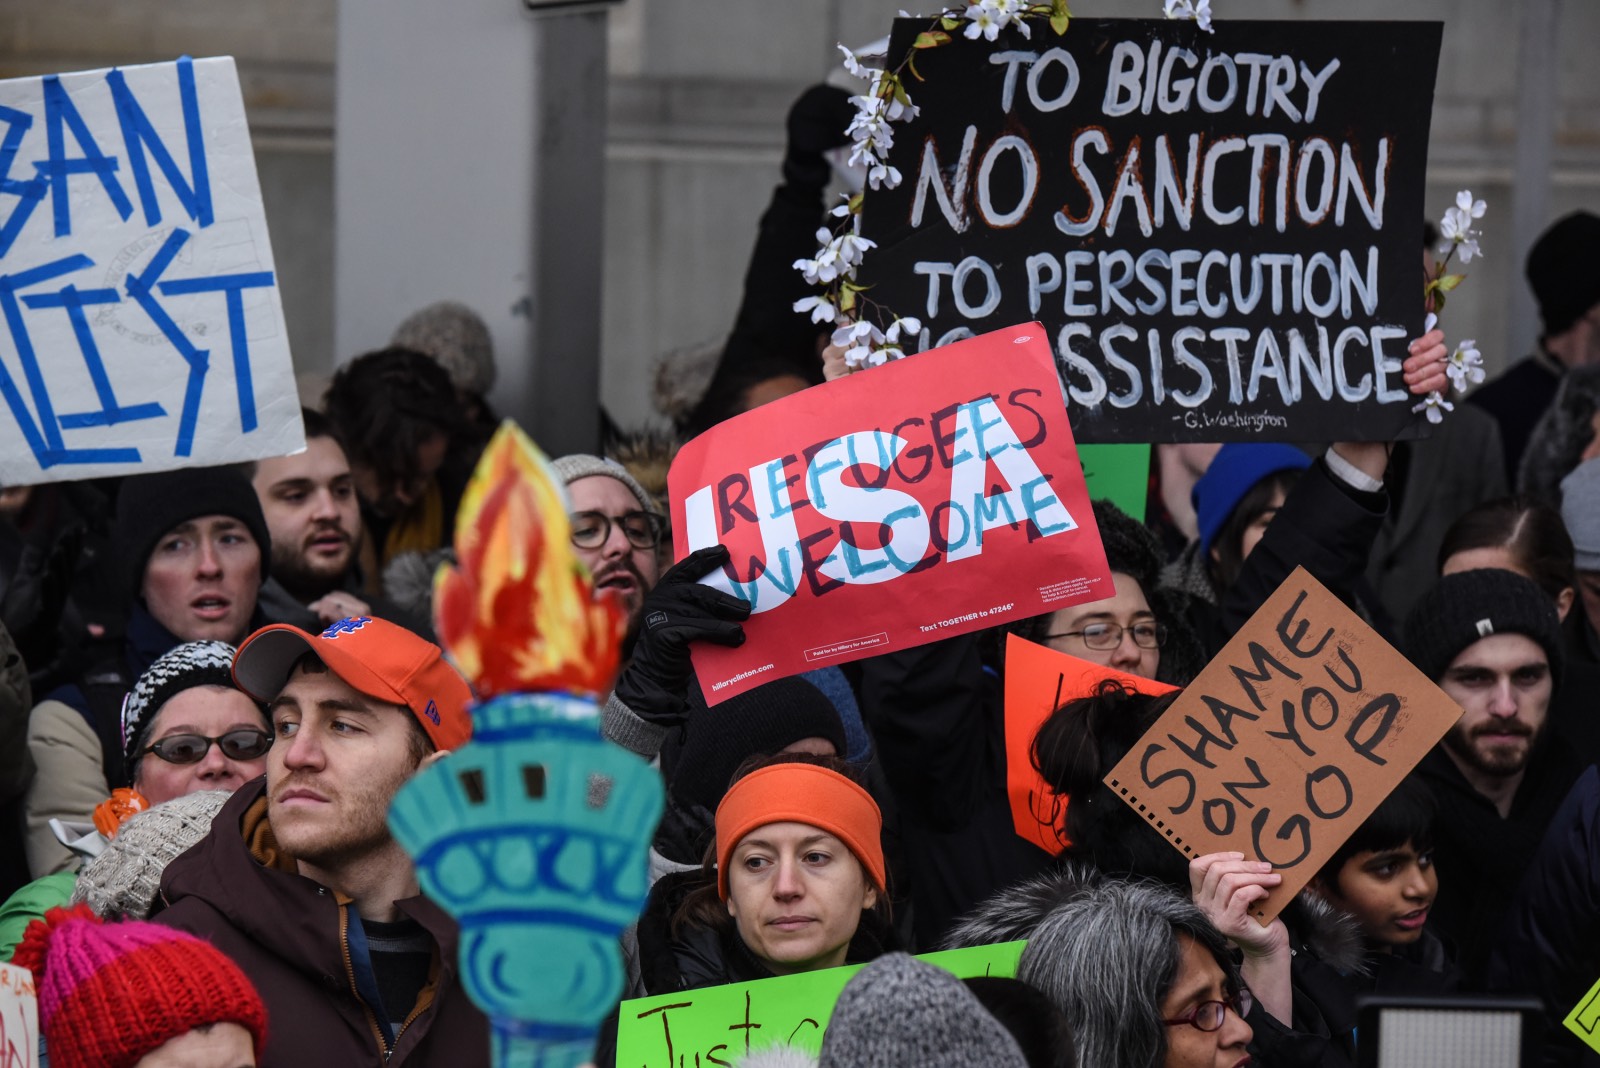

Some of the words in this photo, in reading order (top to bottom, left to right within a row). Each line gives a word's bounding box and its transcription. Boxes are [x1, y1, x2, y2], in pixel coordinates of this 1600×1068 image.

[990, 47, 1080, 114] TO
[1101, 40, 1341, 123] BIGOTRY
[909, 125, 1040, 233] NO
[1054, 126, 1391, 237] SANCTION
[914, 255, 1001, 319] TO
[1026, 246, 1379, 319] PERSECUTION
[1055, 321, 1408, 408] SSISTANCE
[685, 396, 1079, 615] USA
[717, 388, 1048, 536] REFUGEES
[723, 475, 1076, 611] WELCOME
[711, 663, 775, 692] hillaryclinton.com
[919, 623, 938, 633] Text
[938, 612, 979, 628] TOGETHER
[978, 610, 989, 618] to
[1140, 590, 1335, 815] SHAME
[1202, 756, 1271, 836] ON
[1265, 646, 1363, 757] YOU
[1251, 693, 1402, 869] GOP
